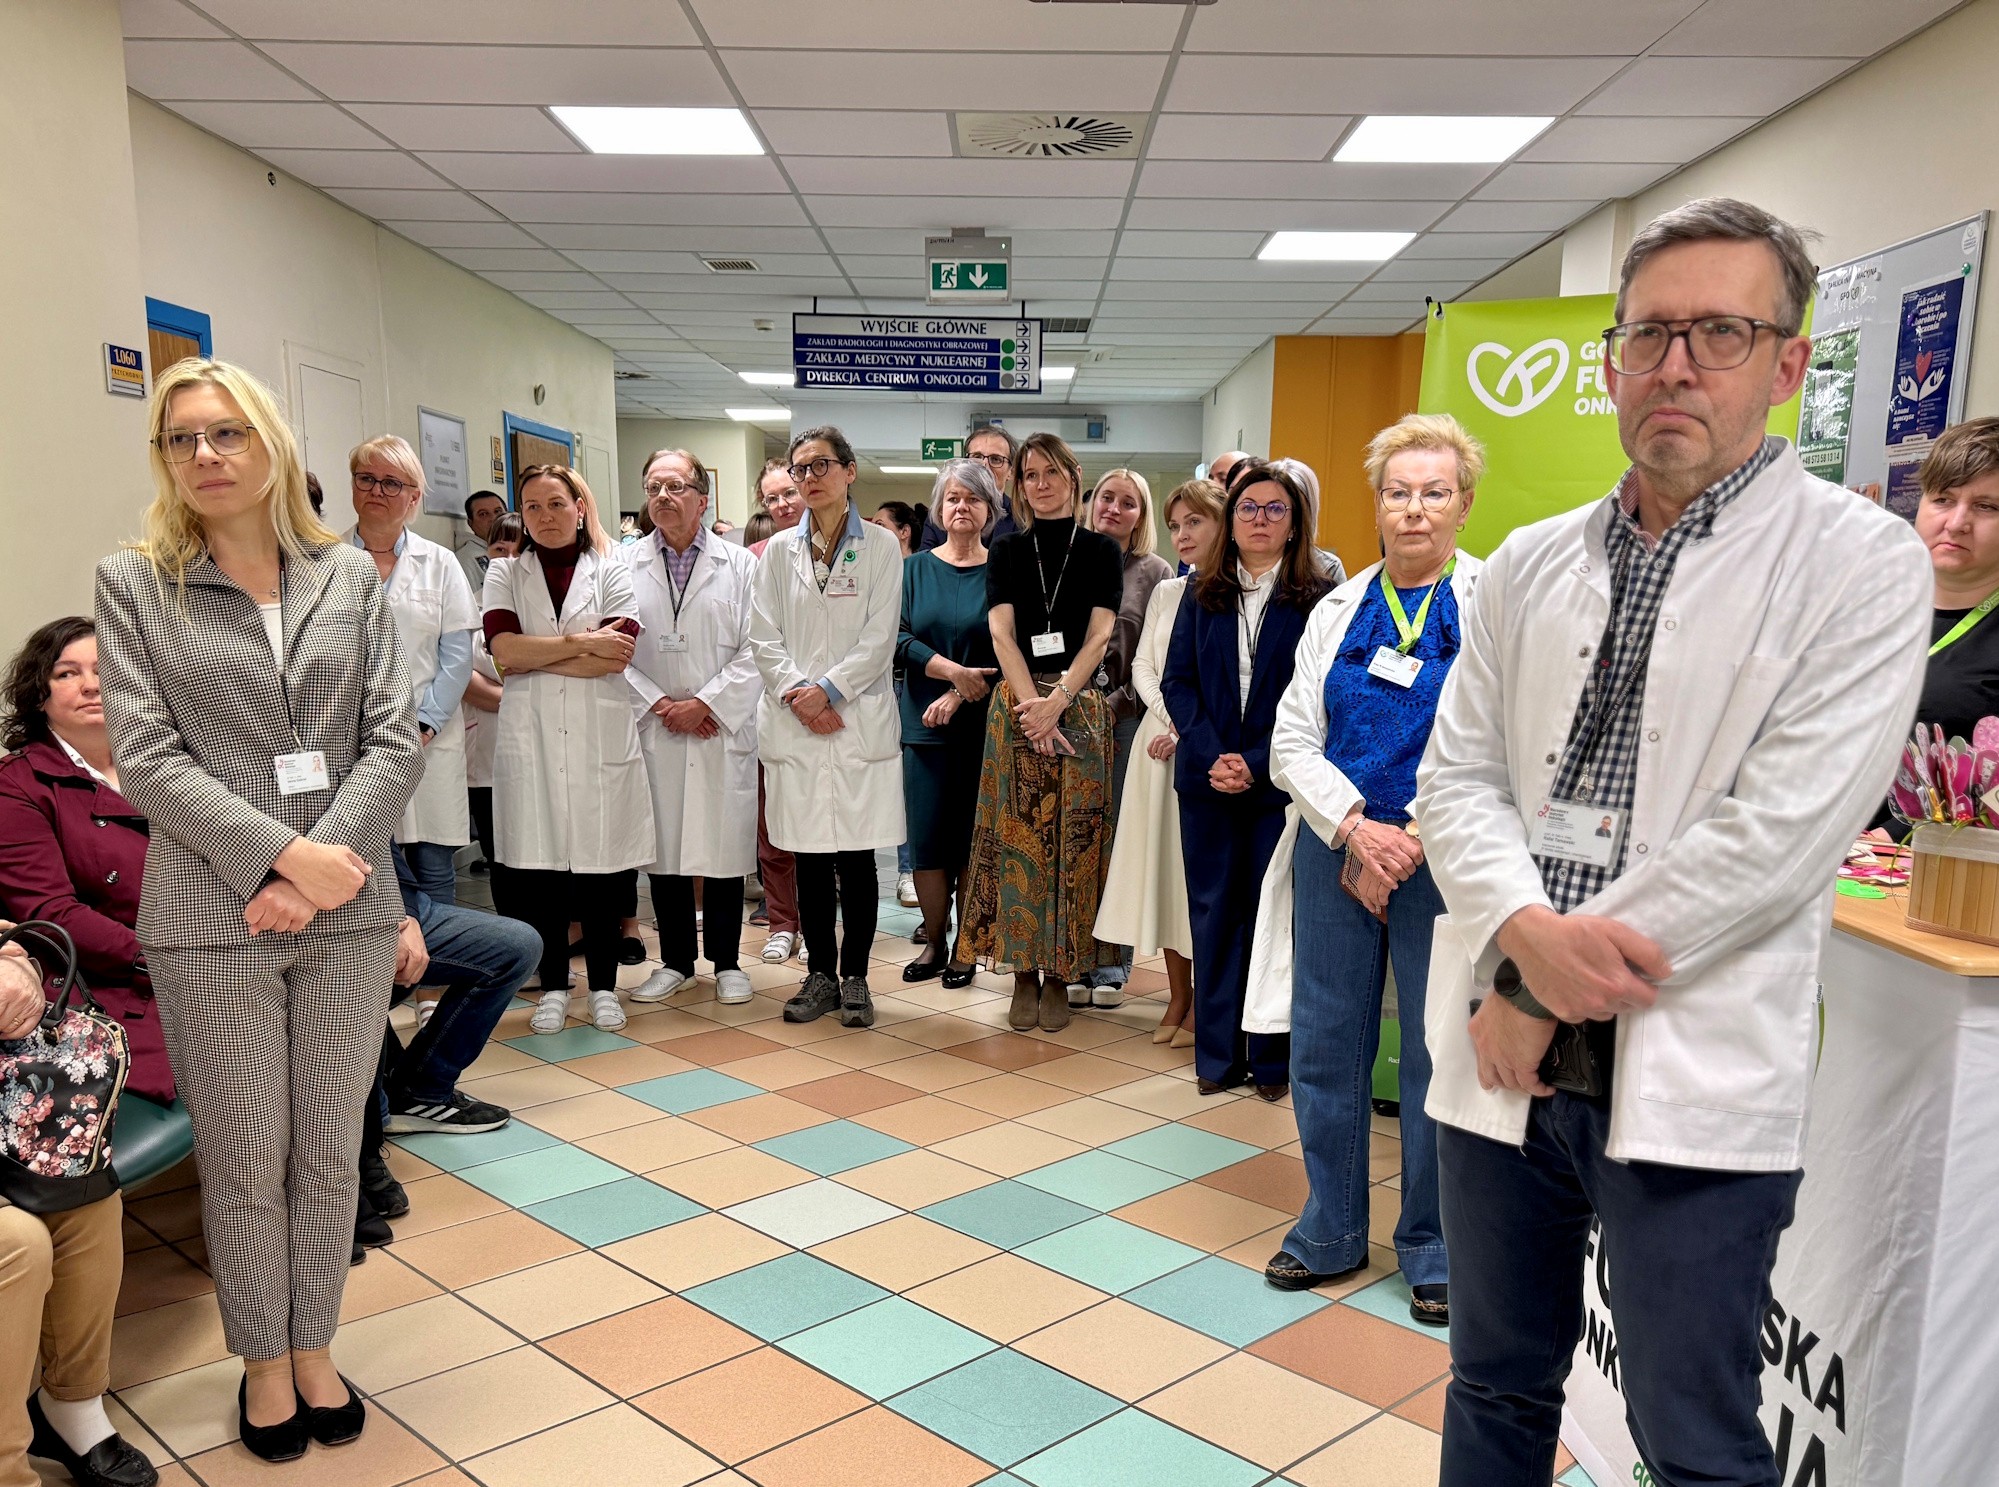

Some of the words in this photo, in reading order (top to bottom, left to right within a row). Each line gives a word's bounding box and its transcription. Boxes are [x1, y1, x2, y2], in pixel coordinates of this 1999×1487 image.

[861, 318, 919, 335] WYJŚCIE
[925, 319, 987, 335] GŁÓWNE
[807, 337, 837, 346] ZAKŁAD
[838, 339, 884, 348] RADIOLOGII
[885, 340, 888, 348] I
[889, 340, 941, 349] DIAGNOSTYKI
[942, 341, 988, 351] OBRAZOWEJ
[113, 348, 136, 367] 1.060
[805, 352, 850, 364] ZAKŁAD
[854, 354, 916, 366] MEDYCYNY
[920, 355, 987, 369] NUKLEARNEJ
[806, 370, 861, 384] DYREKCJA
[865, 372, 920, 384] CENTRUM
[923, 373, 987, 386] ONKOLOGII
